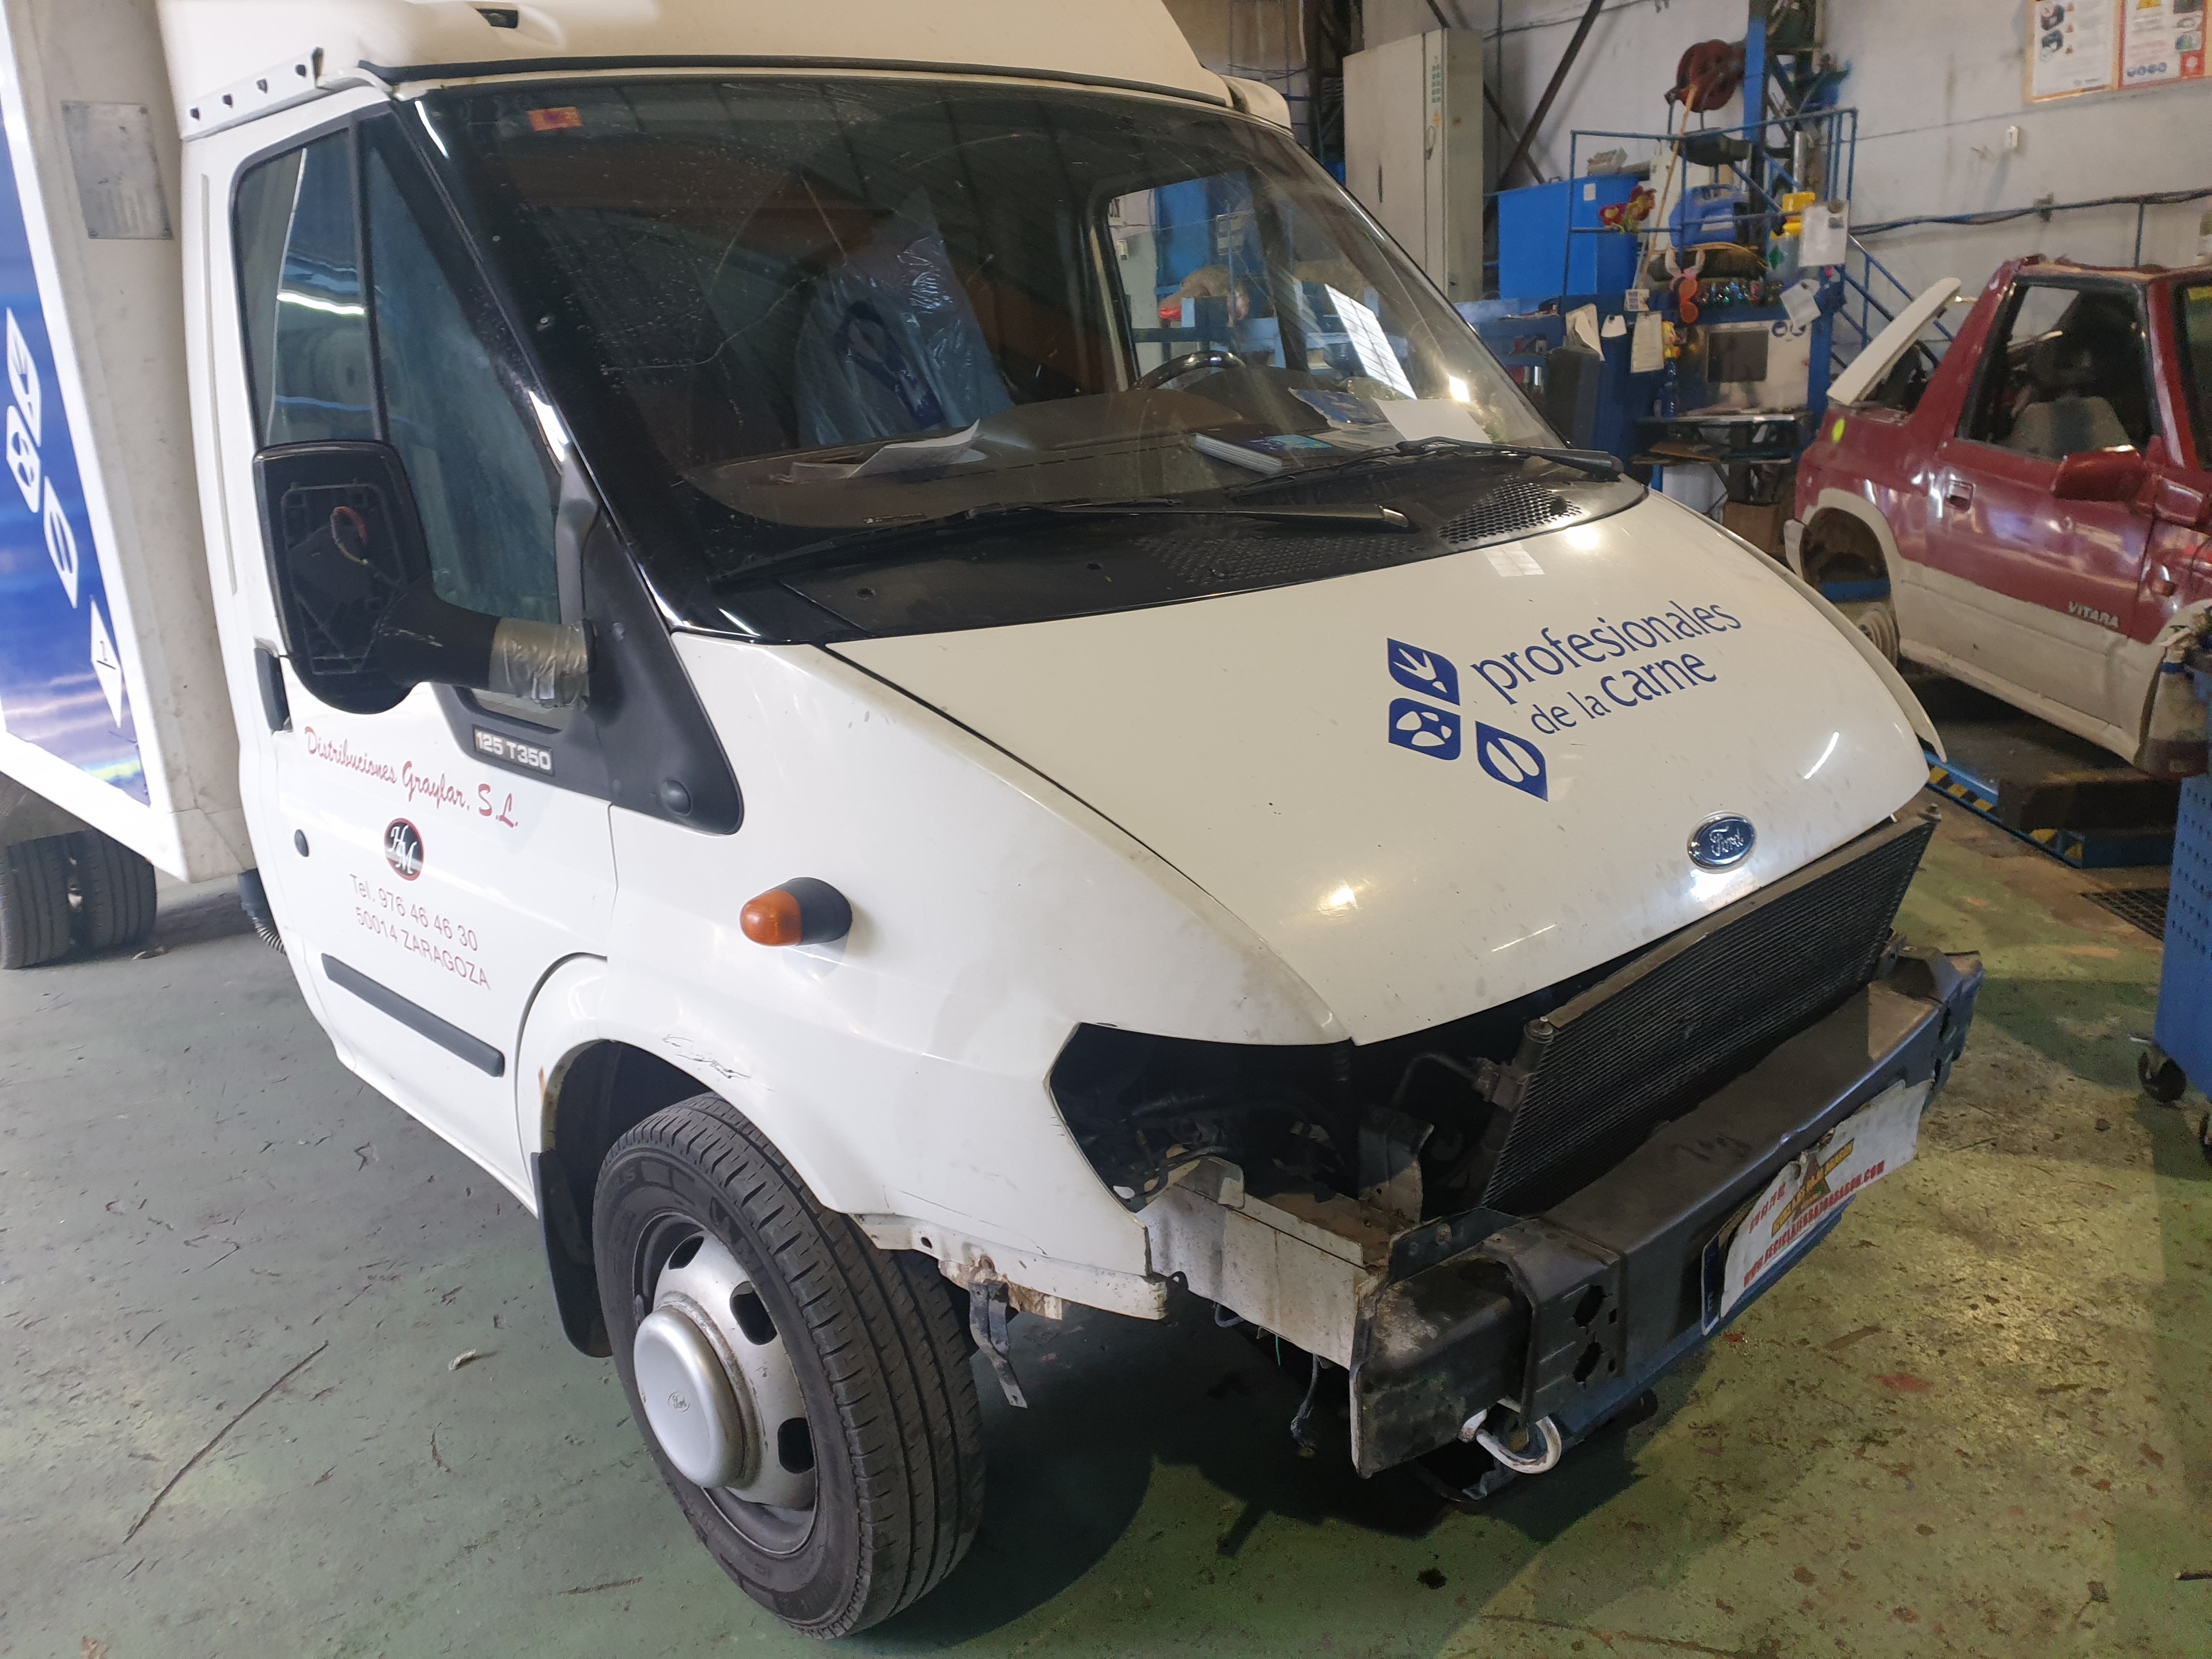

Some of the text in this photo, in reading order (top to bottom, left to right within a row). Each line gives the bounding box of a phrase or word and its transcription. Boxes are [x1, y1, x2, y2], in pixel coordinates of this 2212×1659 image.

[2068, 601, 2119, 628] VITARA
[1470, 600, 1741, 705] profesionales
[1531, 654, 1717, 734] de la carne
[304, 726, 397, 784] Distribuciones
[476, 732, 551, 770] 125 T350
[1709, 826, 1744, 857] Ford
[350, 873, 478, 951] Tel. 976 46 46 30
[355, 906, 491, 991] 50014 ZARAGOZA
